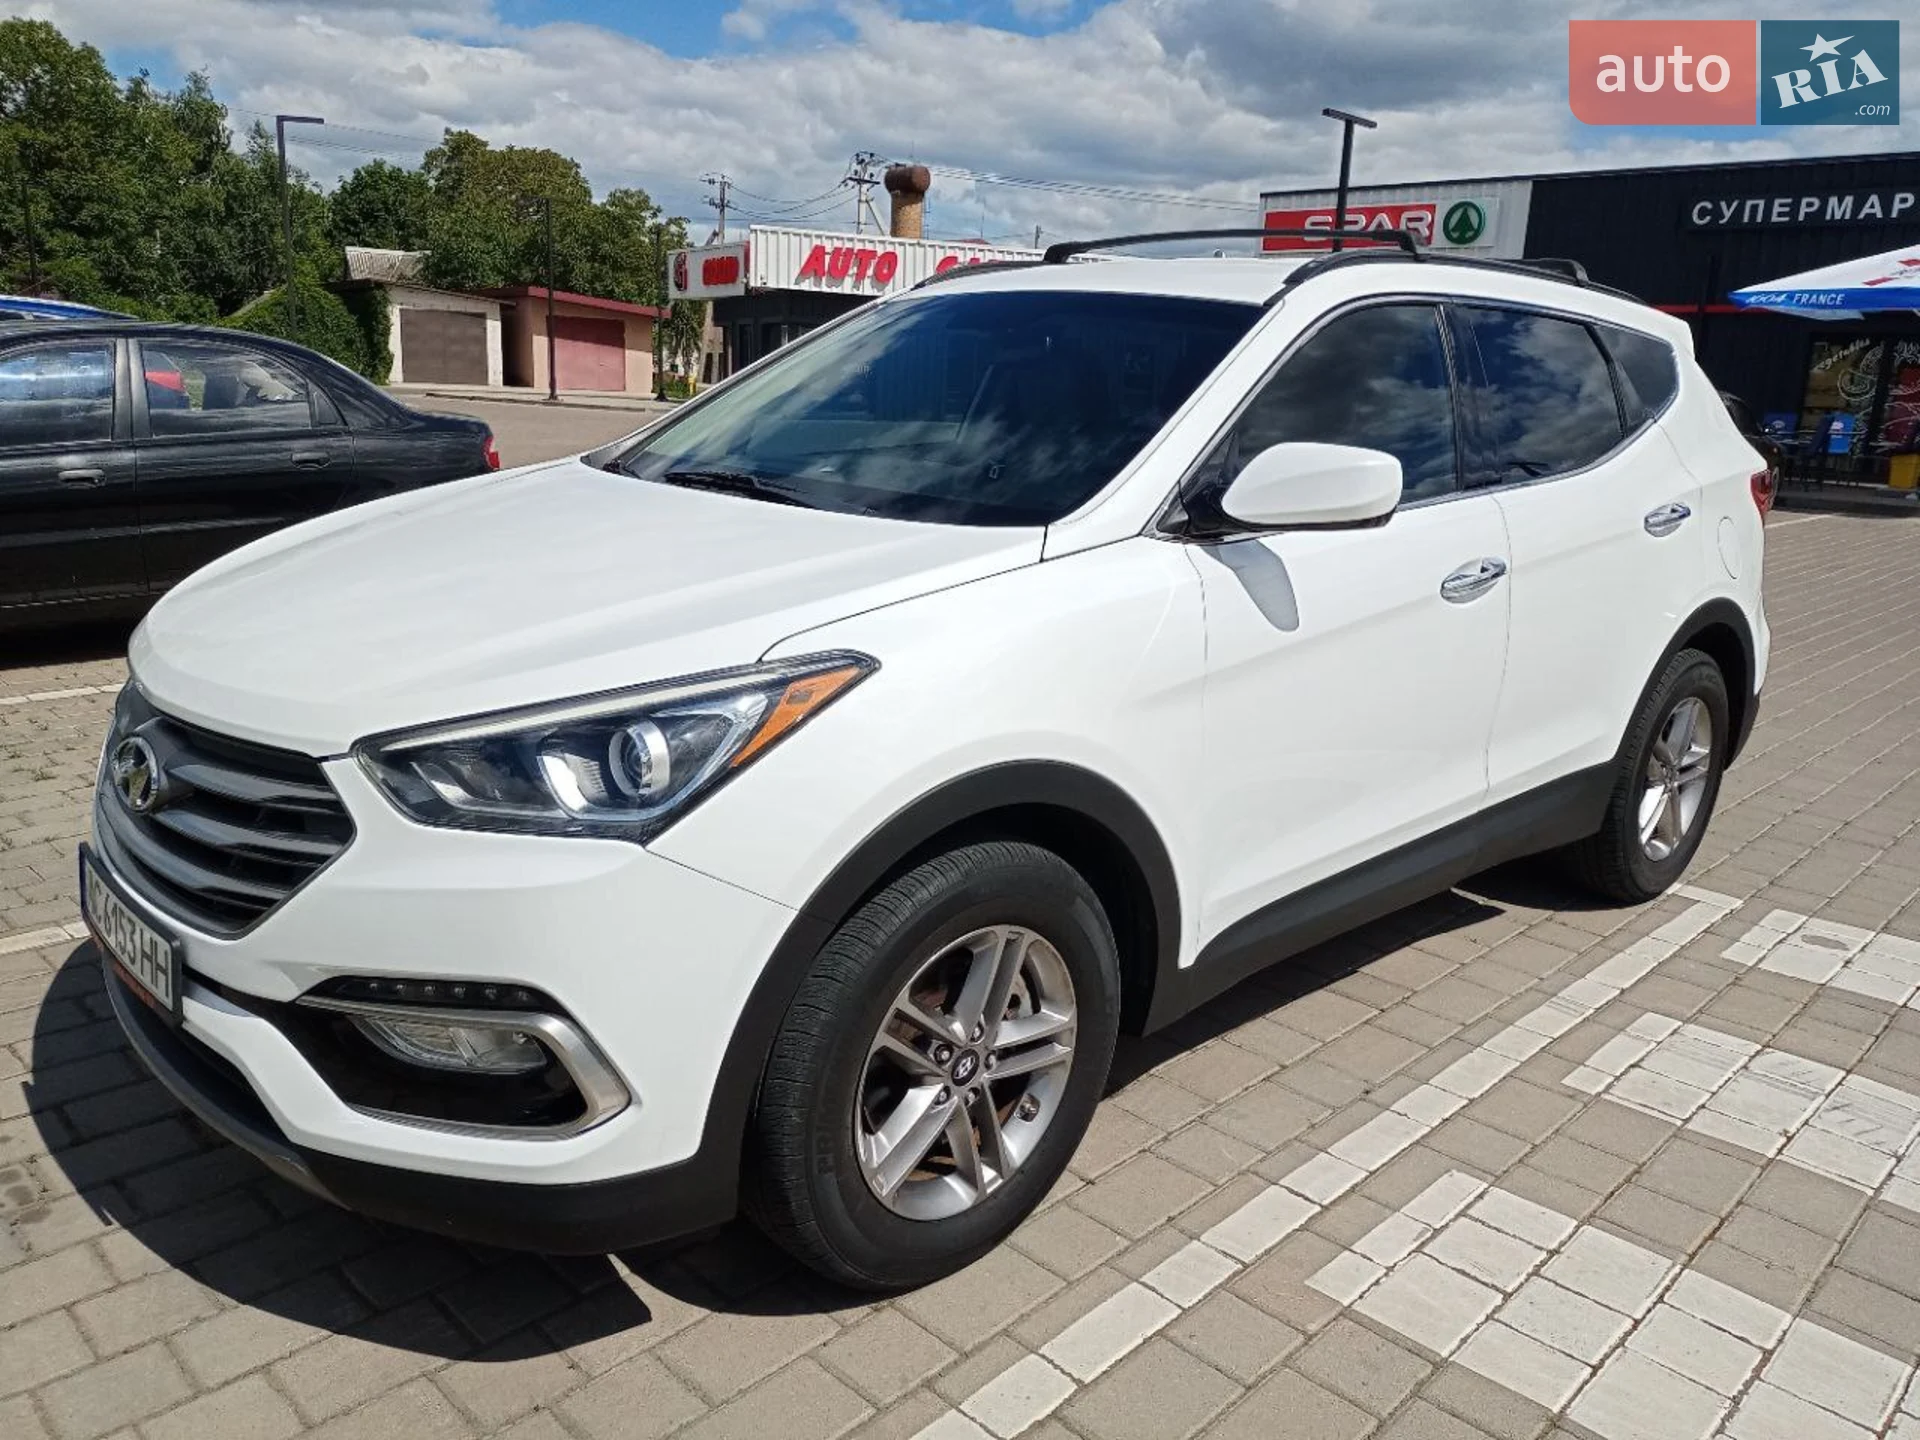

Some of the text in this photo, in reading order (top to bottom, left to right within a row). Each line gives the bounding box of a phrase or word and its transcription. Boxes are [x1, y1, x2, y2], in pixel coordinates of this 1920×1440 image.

[1692, 192, 1915, 225] СУПЕРМАР
[799, 245, 898, 284] AUTO
[1793, 293, 1845, 306] FRANCE
[103, 893, 137, 966] 6153
[139, 927, 170, 999] HH
